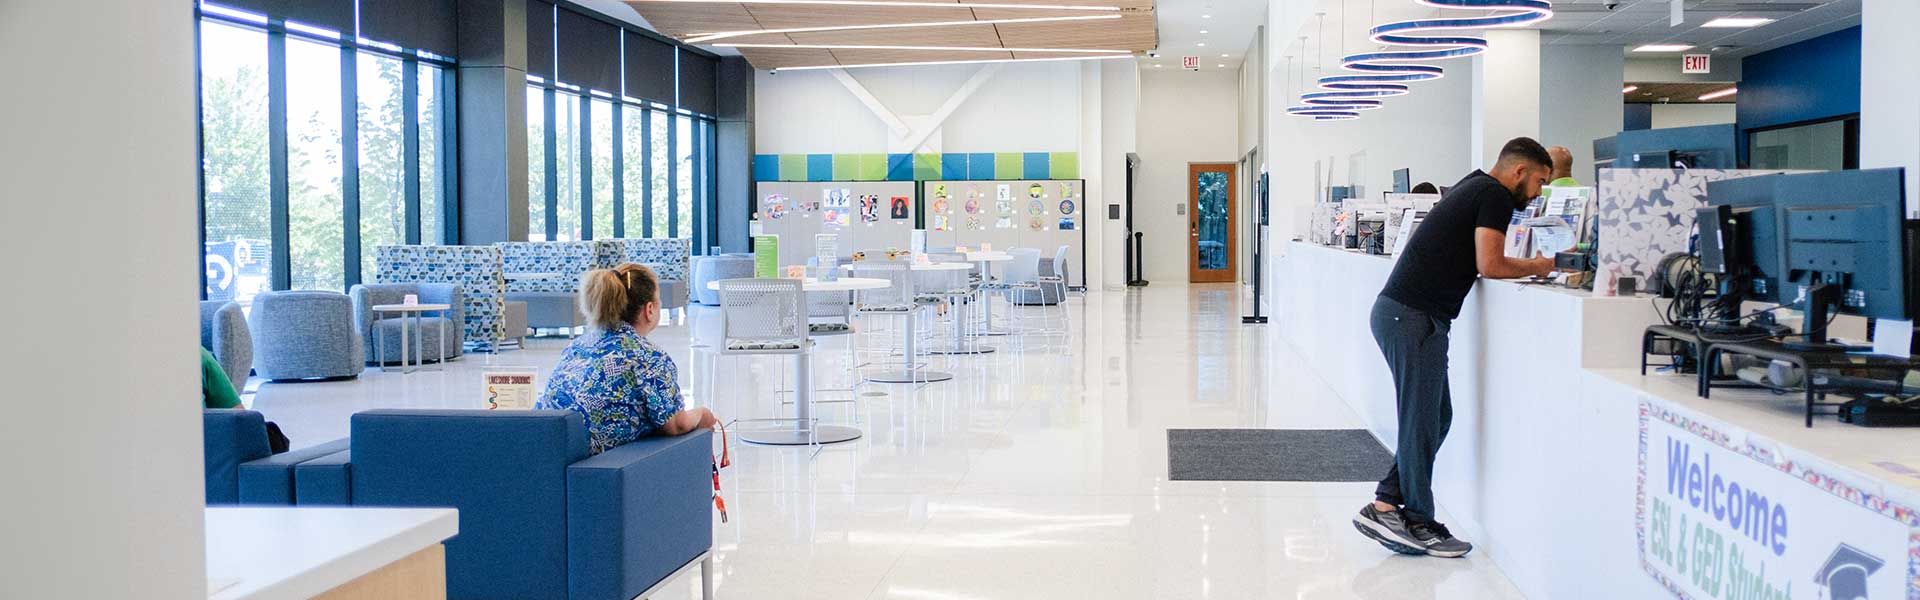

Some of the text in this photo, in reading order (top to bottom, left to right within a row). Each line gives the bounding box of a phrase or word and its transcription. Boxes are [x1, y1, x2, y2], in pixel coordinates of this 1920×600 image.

[1183, 56, 1199, 66] EXIT
[1685, 56, 1707, 70] EXIT
[1667, 436, 1787, 556] Welcome
[1651, 497, 1673, 567] ESL
[1677, 512, 1687, 575] &
[1692, 522, 1724, 598] GED
